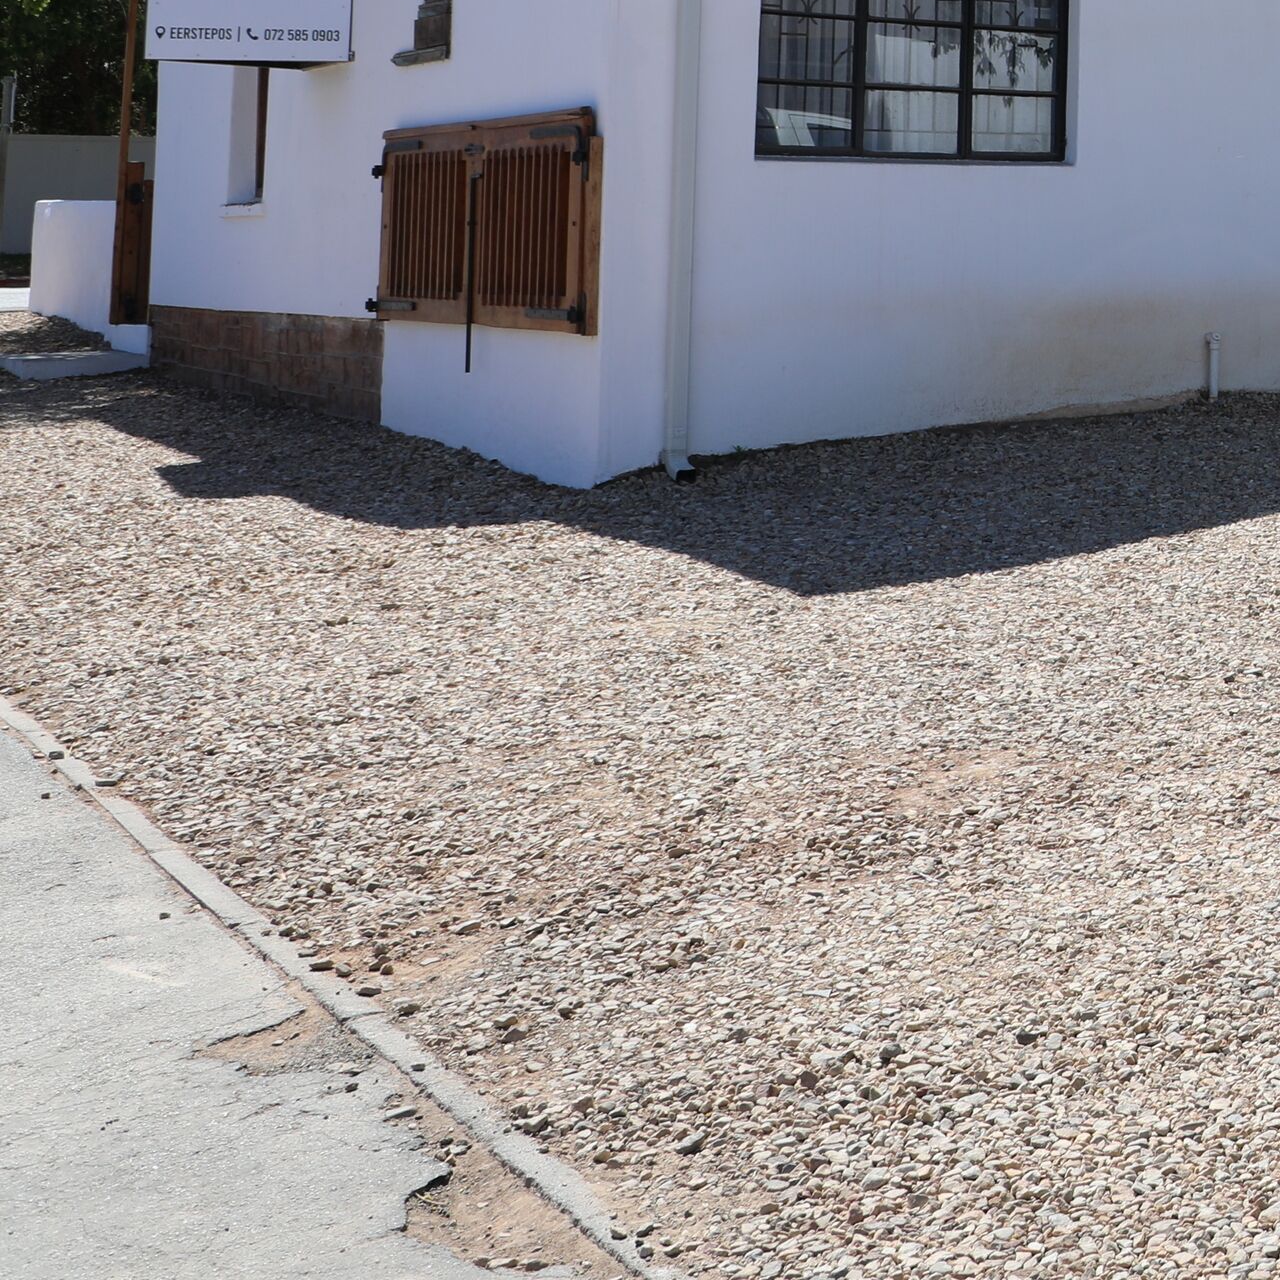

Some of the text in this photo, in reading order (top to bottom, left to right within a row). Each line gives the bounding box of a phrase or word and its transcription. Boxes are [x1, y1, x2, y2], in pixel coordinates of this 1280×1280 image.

[170, 27, 340, 42] EERSTEPOS 072 585 0903
